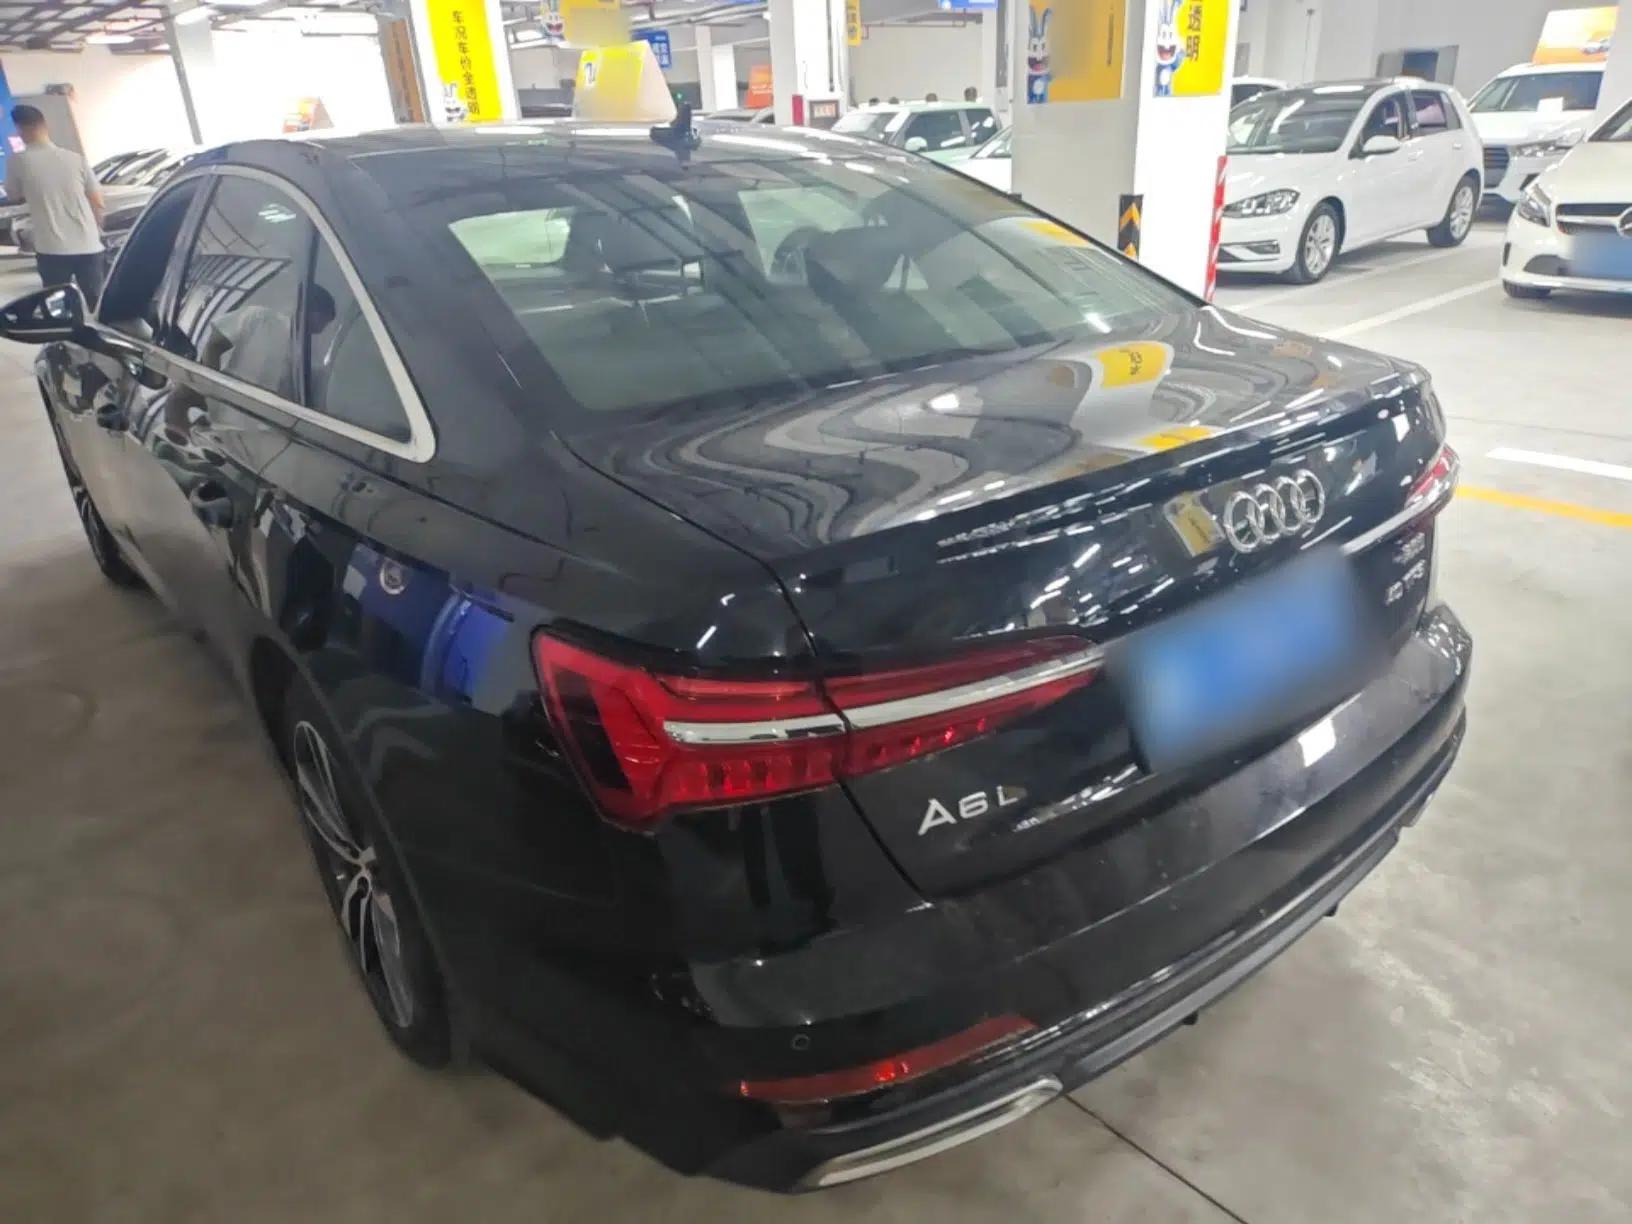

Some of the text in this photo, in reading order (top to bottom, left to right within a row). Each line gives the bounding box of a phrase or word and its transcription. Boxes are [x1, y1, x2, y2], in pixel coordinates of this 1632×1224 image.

[452, 10, 480, 115] 车况车价全透明
[917, 785, 1019, 836] A6L
